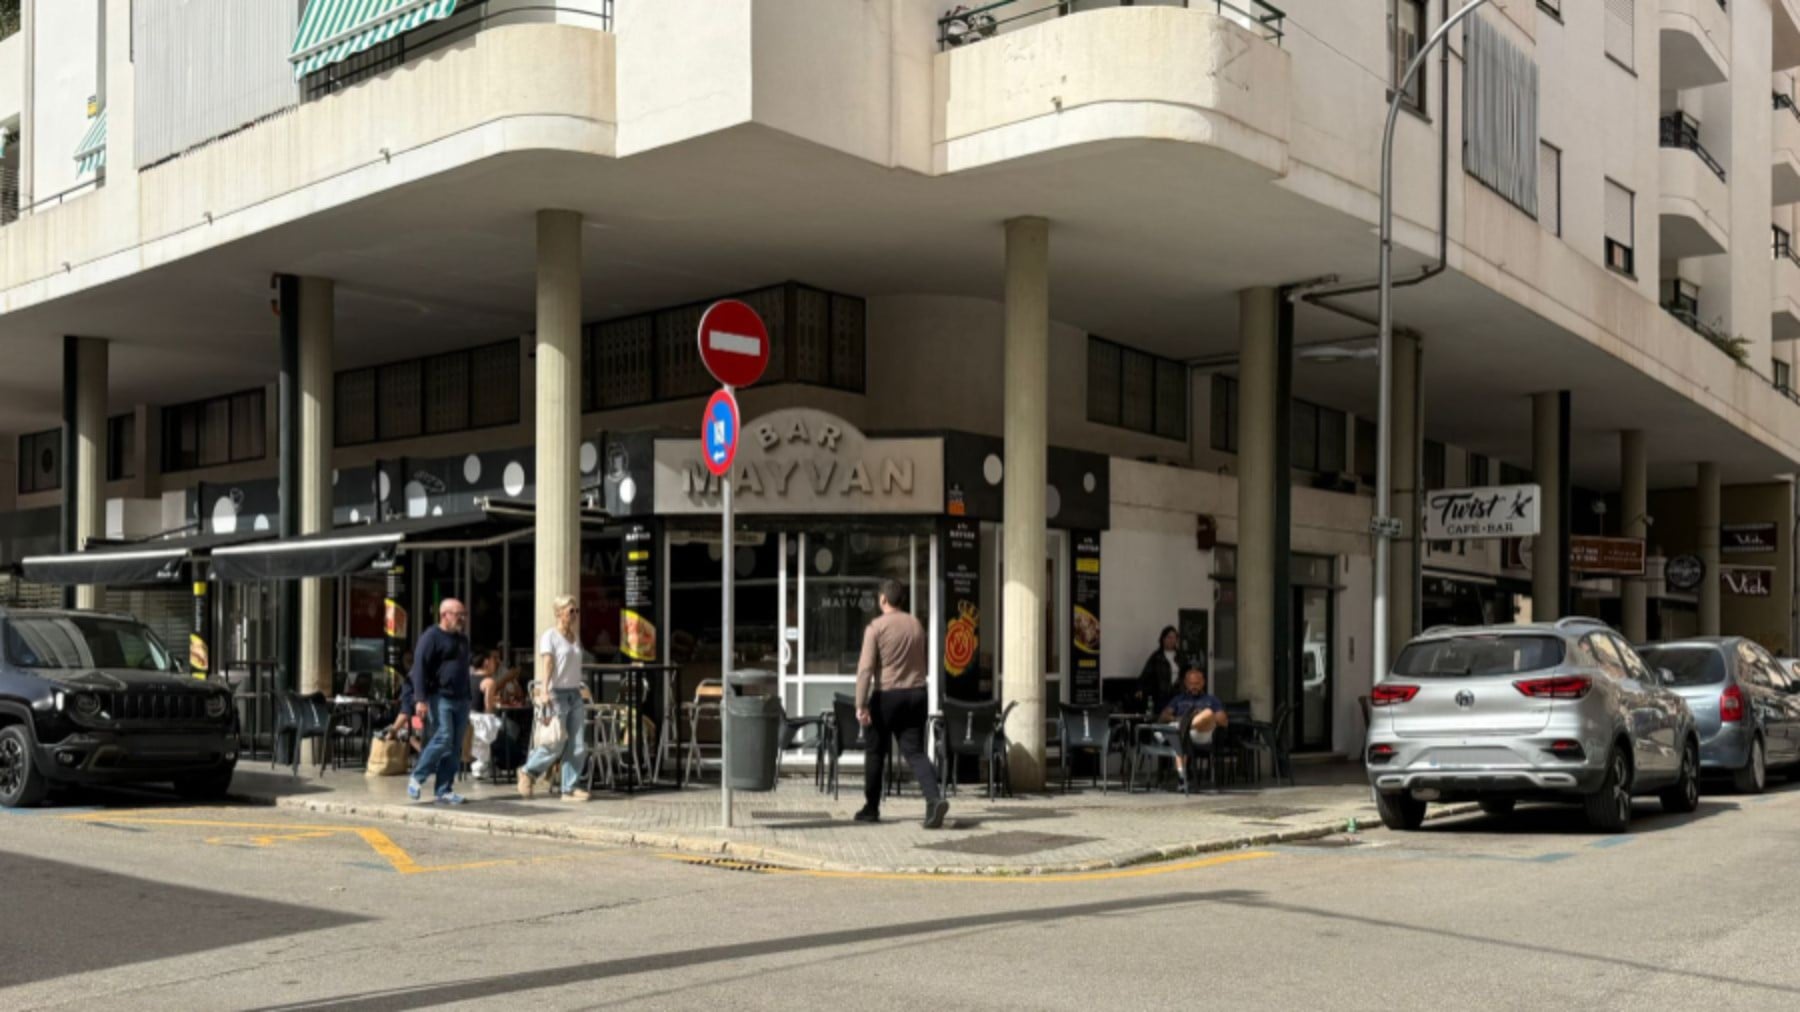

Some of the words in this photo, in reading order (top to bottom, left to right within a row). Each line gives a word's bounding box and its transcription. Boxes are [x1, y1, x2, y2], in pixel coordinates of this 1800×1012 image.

[757, 417, 842, 451] BAR
[682, 456, 915, 497] MAYVAN
[1431, 491, 1505, 526] Twist
